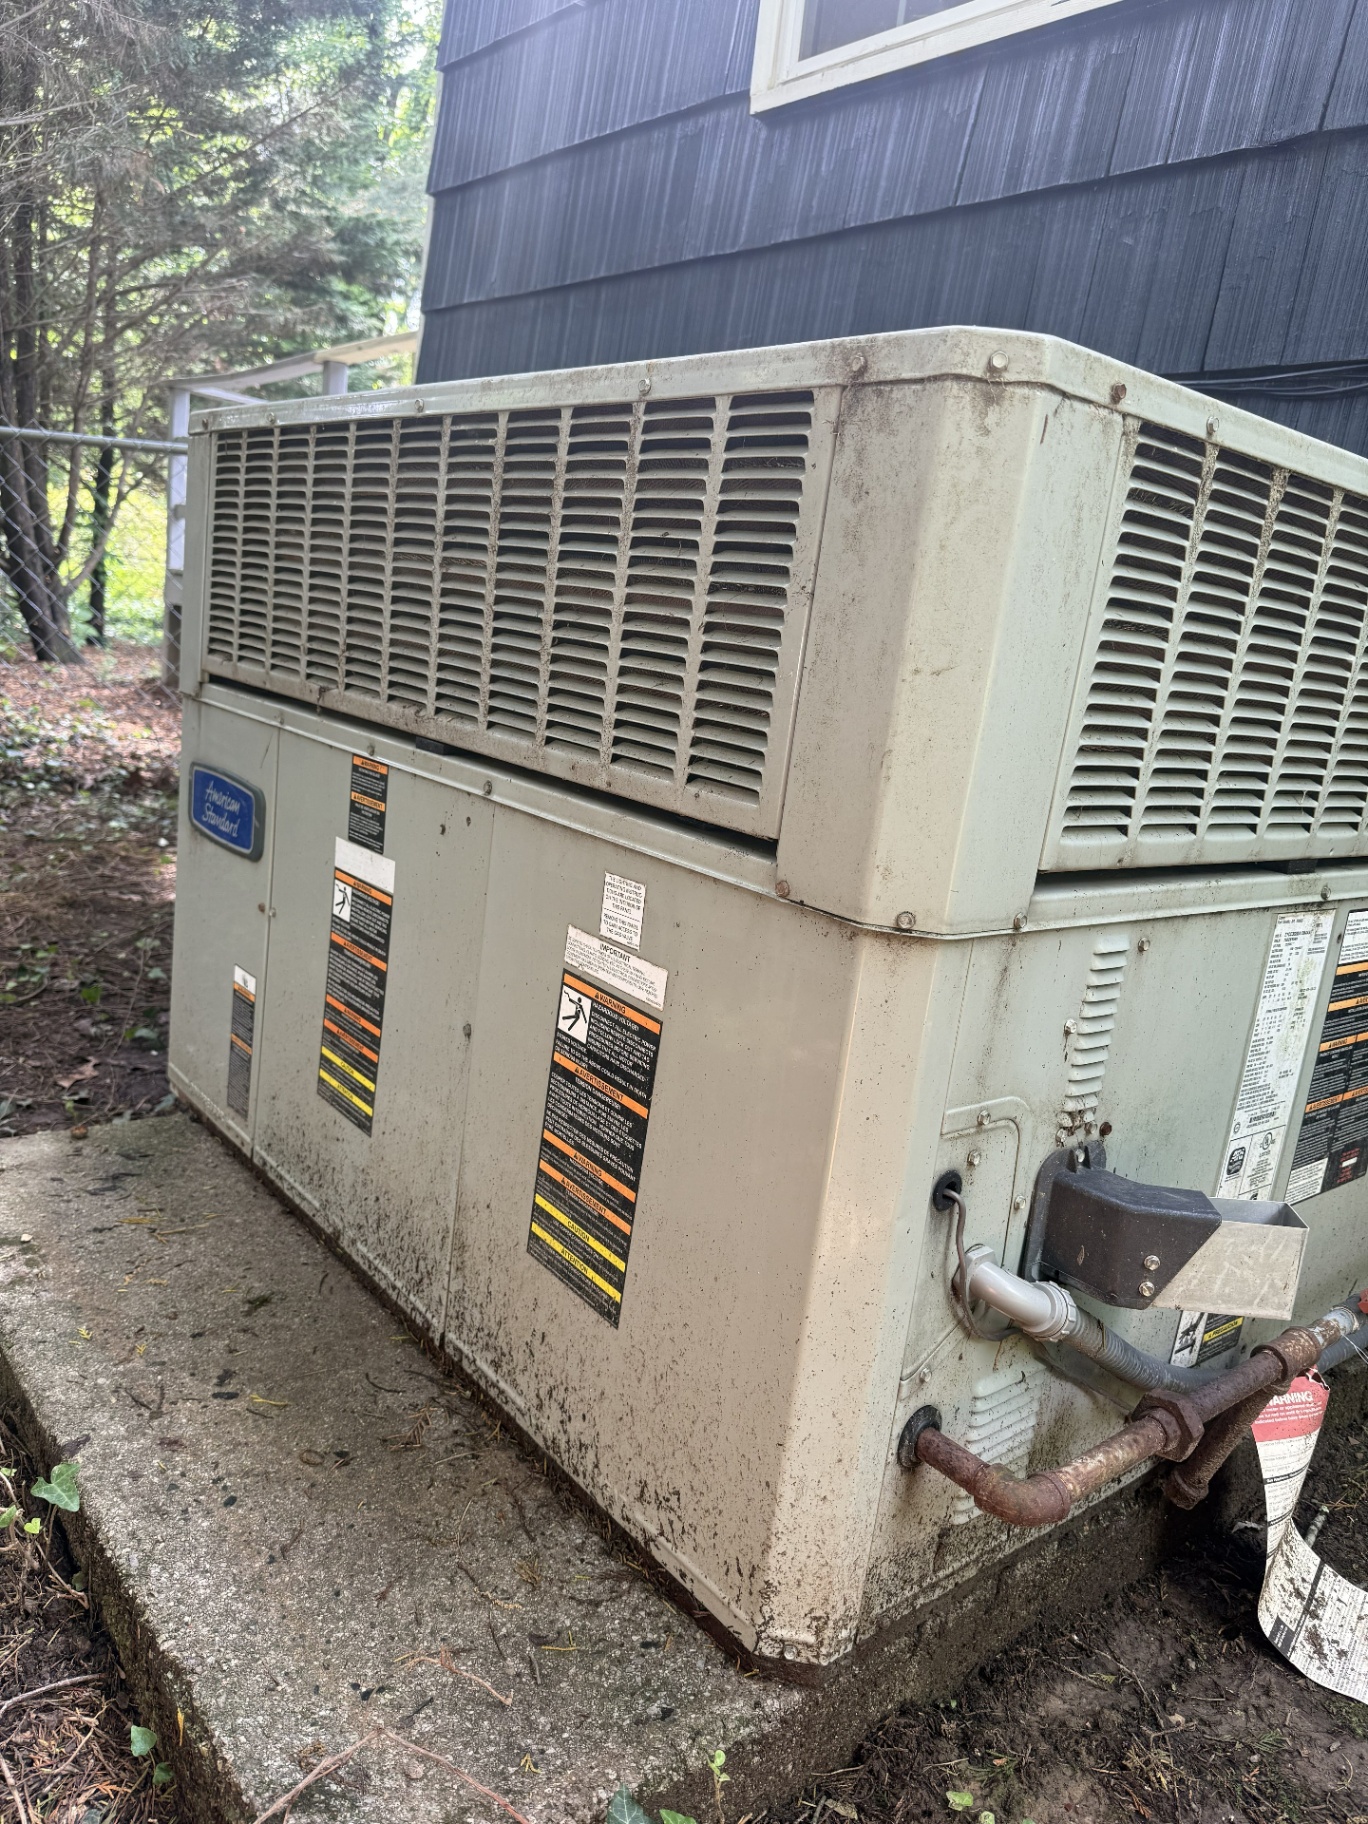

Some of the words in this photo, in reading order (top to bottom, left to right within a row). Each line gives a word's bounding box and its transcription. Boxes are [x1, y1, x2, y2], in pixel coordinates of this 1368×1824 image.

[205, 781, 240, 815] American
[202, 803, 240, 837] Standard
[599, 942, 630, 963] IMPORTANT
[599, 993, 626, 1014] WARNING
[641, 1038, 656, 1051] POWER
[579, 1068, 623, 1102] AVERTISSEMENT
[577, 1154, 602, 1177] WARNING
[565, 1179, 606, 1215] AVERTISSEMENT
[567, 1219, 589, 1242] CAUTION
[560, 1246, 588, 1275] ATTENTION
